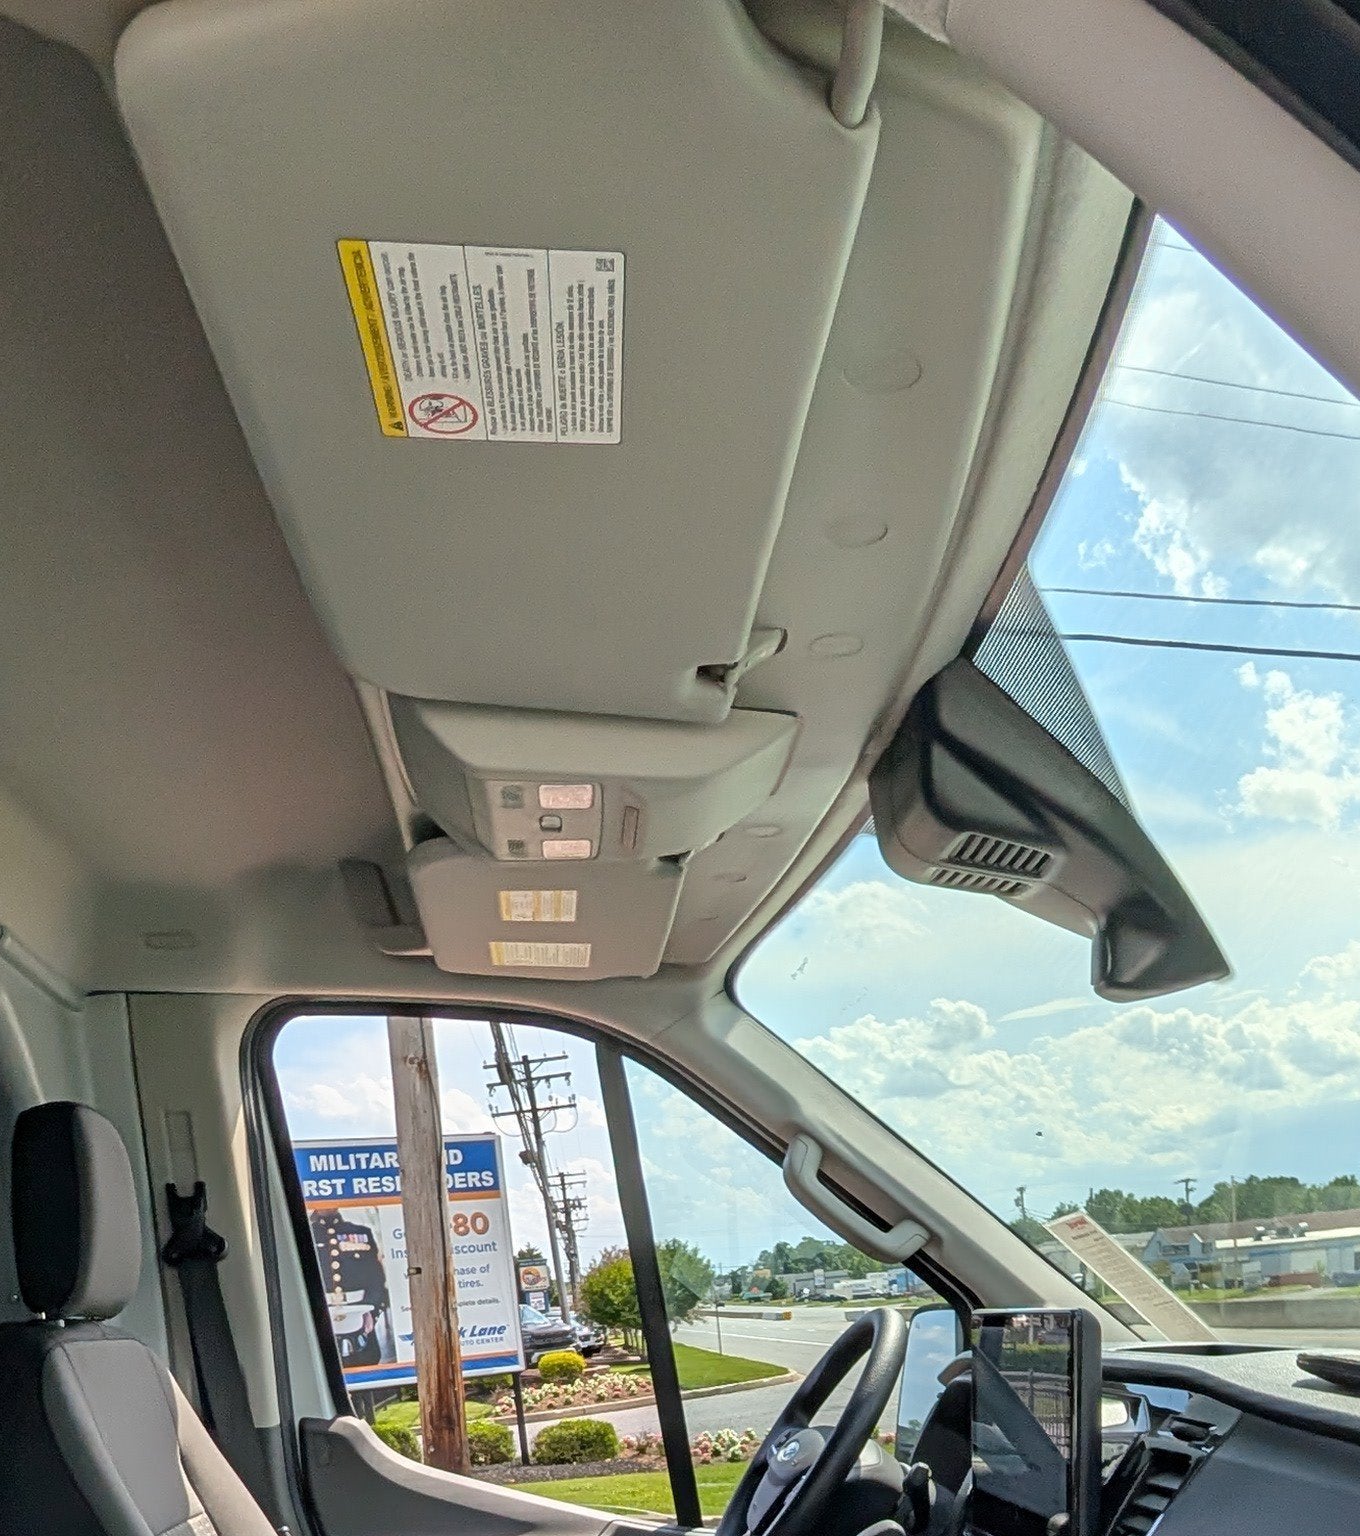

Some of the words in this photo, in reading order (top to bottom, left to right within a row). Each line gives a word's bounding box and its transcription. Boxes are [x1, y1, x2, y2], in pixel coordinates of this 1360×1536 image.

[309, 1151, 400, 1172] MILITAR
[302, 1178, 346, 1197] RST
[353, 1170, 495, 1194] RESDERS
[452, 1211, 490, 1236] 80
[454, 1240, 498, 1255] scount
[469, 1324, 507, 1338] Lane
